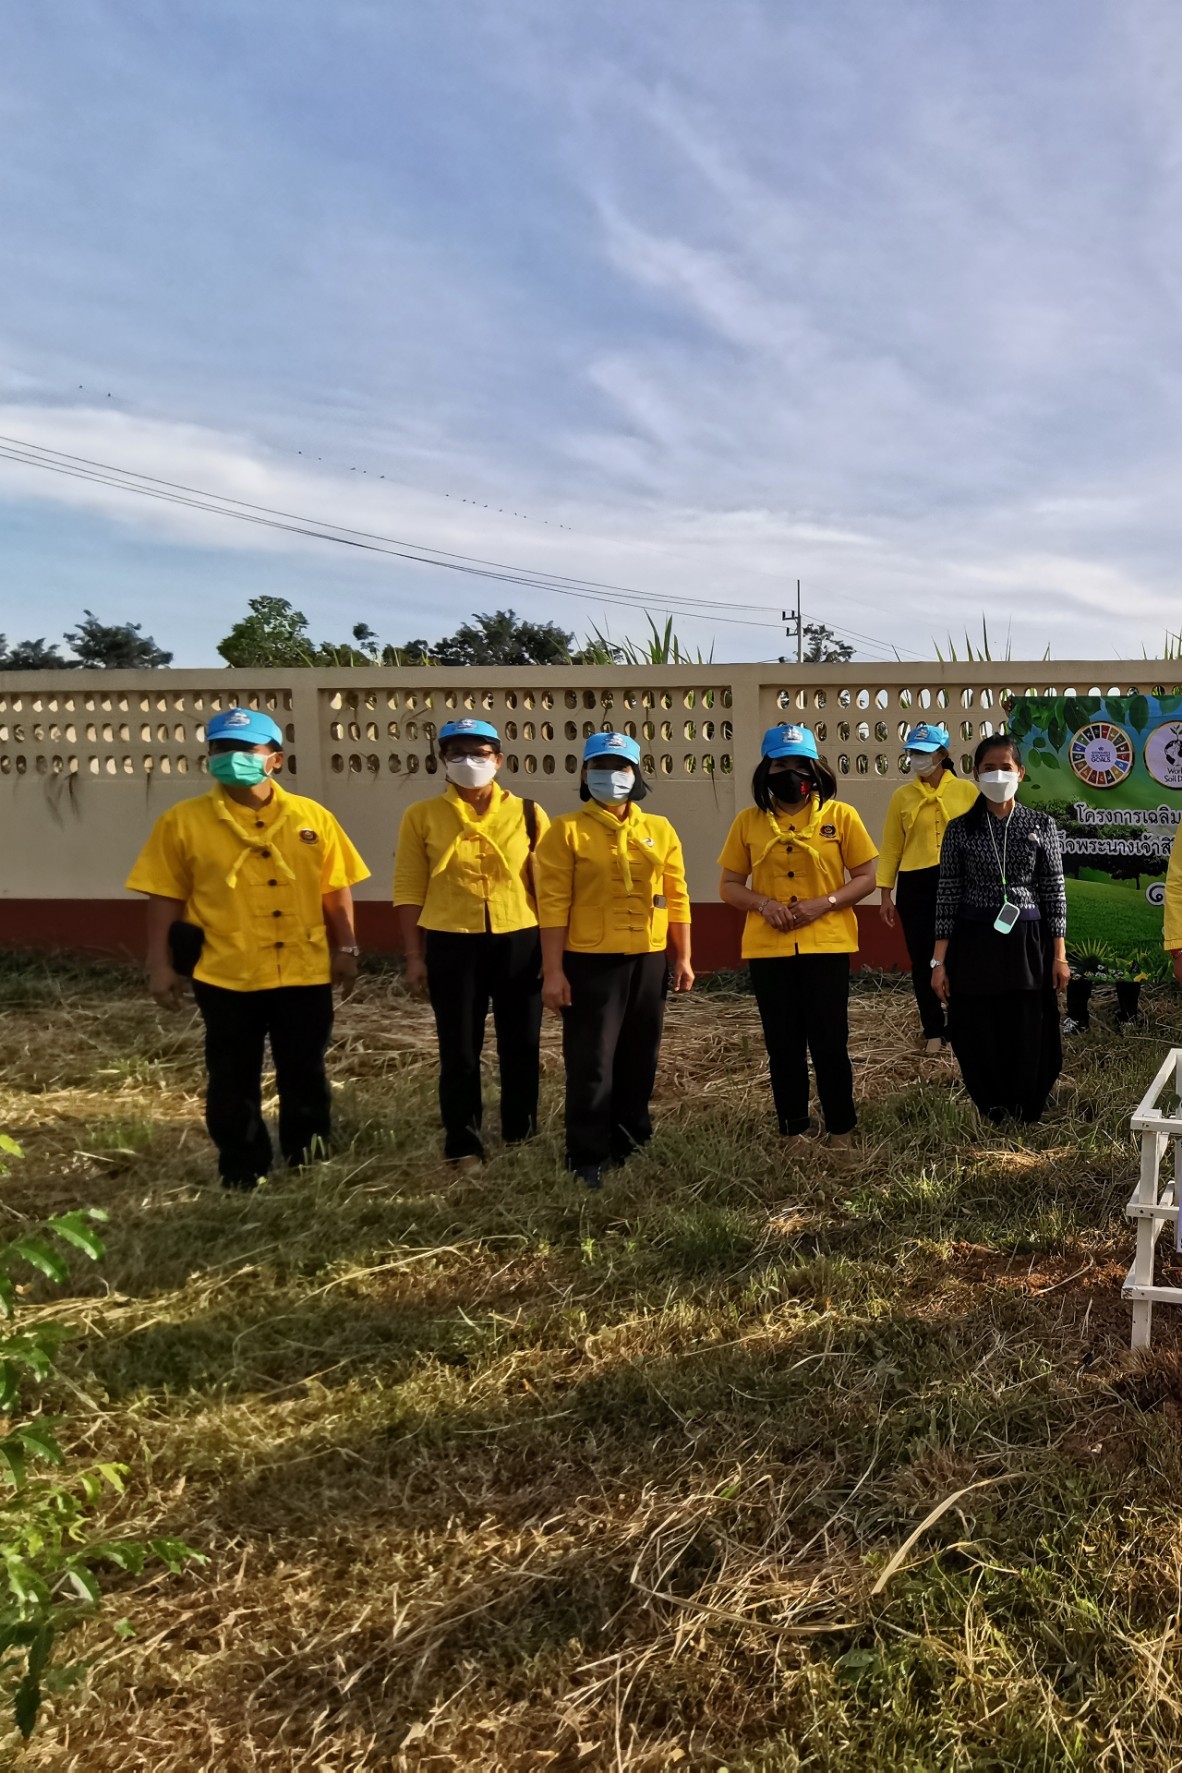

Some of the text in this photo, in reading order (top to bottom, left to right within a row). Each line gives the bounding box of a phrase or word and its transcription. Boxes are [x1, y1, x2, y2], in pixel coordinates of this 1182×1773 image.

[1164, 774, 1177, 783] Soil
[1075, 803, 1181, 825] โครงการเฉลิม
